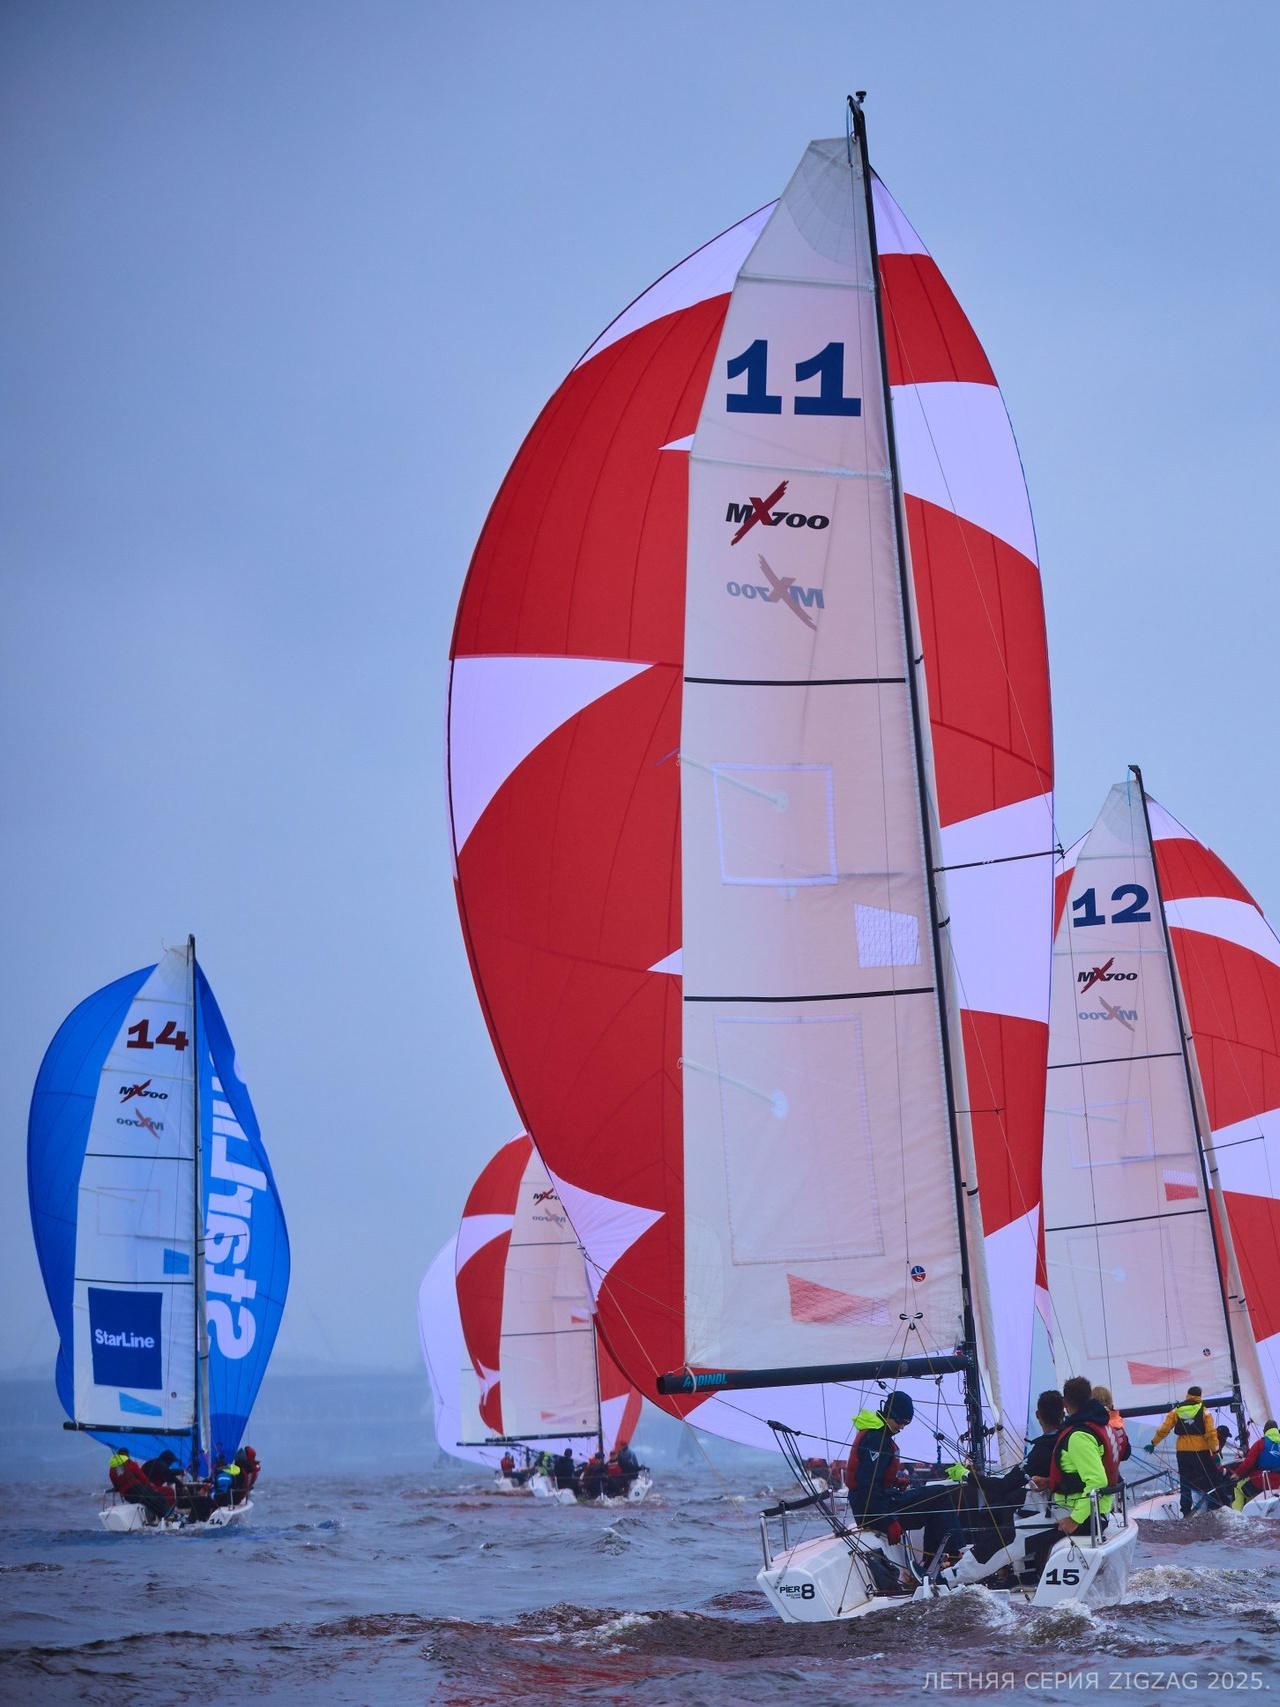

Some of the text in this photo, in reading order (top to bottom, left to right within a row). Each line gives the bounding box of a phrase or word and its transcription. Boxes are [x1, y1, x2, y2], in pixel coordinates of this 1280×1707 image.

[726, 339, 861, 416] 11
[725, 479, 830, 546] MX700
[1072, 884, 1151, 928] 12
[1077, 957, 1138, 994] MX700
[126, 1019, 189, 1051] 14
[119, 1079, 168, 1104] MX700
[95, 1328, 155, 1349] StarLine
[801, 1583, 816, 1600] 8
[1045, 1568, 1080, 1586] 15
